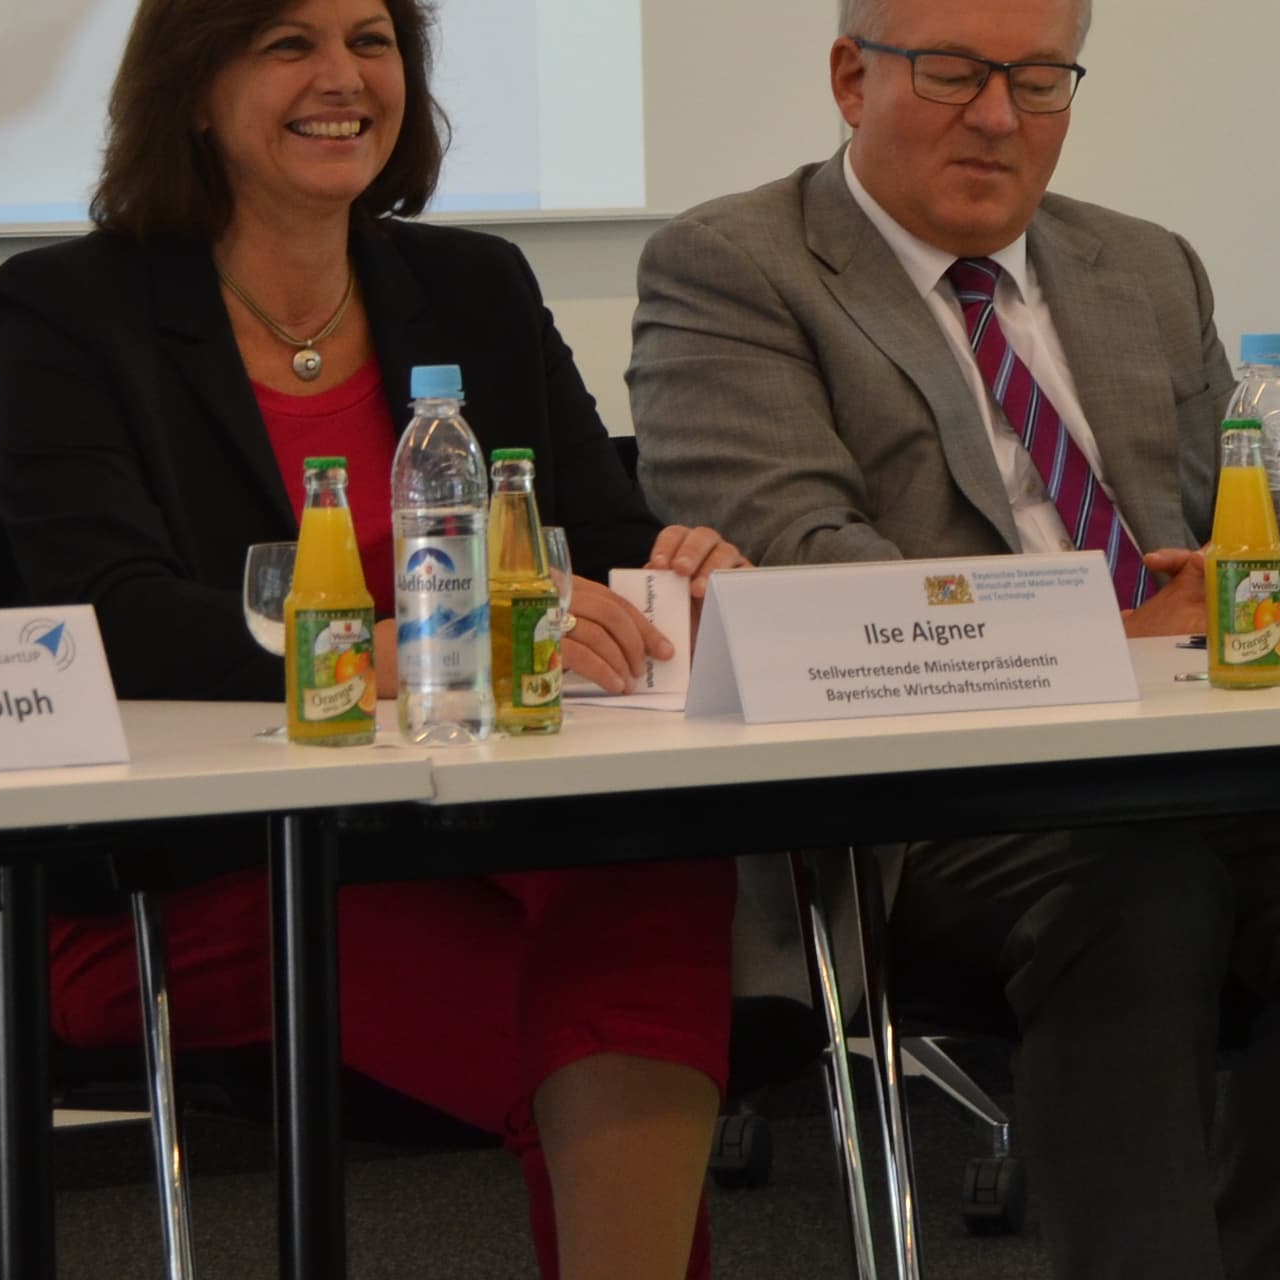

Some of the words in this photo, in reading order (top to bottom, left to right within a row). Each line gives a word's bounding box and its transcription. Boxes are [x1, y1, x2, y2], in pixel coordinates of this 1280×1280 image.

[864, 623, 905, 645] Ilse
[911, 620, 986, 646] Aigner
[1231, 629, 1272, 651] Orange
[808, 659, 921, 681] Stellvertretende
[924, 653, 1059, 676] Ministerpräsidentin
[826, 684, 901, 704] Bayerische
[903, 675, 1051, 698] Wirtschaftsministerin
